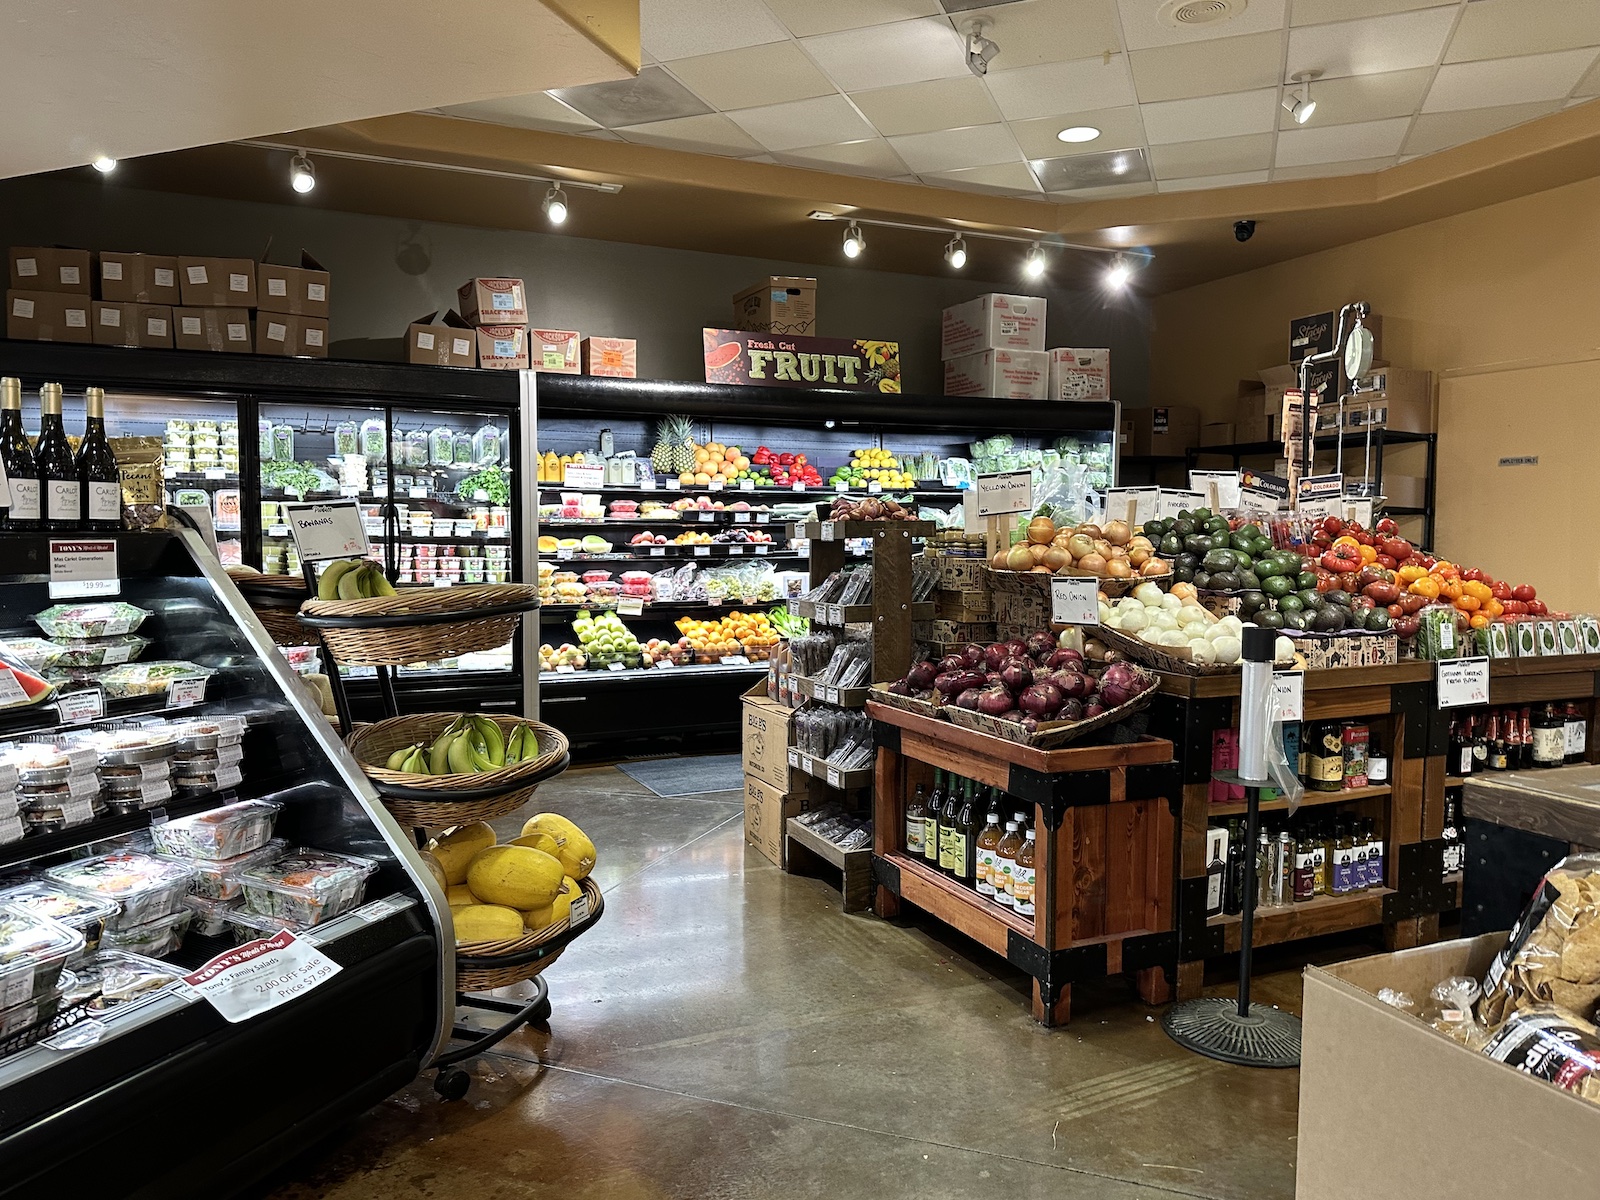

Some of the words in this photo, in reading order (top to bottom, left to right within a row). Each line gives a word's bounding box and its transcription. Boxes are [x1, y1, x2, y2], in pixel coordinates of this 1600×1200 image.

[1298, 324, 1328, 341] Stacy's
[747, 340, 775, 350] Fresh
[779, 342, 796, 350] Cut
[748, 350, 862, 385] FRUIT
[1310, 370, 1333, 386] tacy's
[122, 470, 152, 480] Pecans
[980, 482, 1006, 492] YELLOW
[1008, 481, 1026, 490] ONION
[1260, 480, 1286, 493] COLORADO
[298, 518, 333, 528] BANANAS
[1054, 590, 1067, 600] RED
[1069, 591, 1087, 601] ONION
[194, 954, 242, 981] TONY'S
[202, 978, 230, 991] Tony's
[229, 968, 254, 978] Family
[254, 958, 279, 970] Salads
[254, 980, 280, 992] $2.00
[280, 971, 298, 983] OFF
[299, 958, 321, 974] Sale
[278, 984, 304, 997] Price
[304, 966, 332, 985] $7.99
